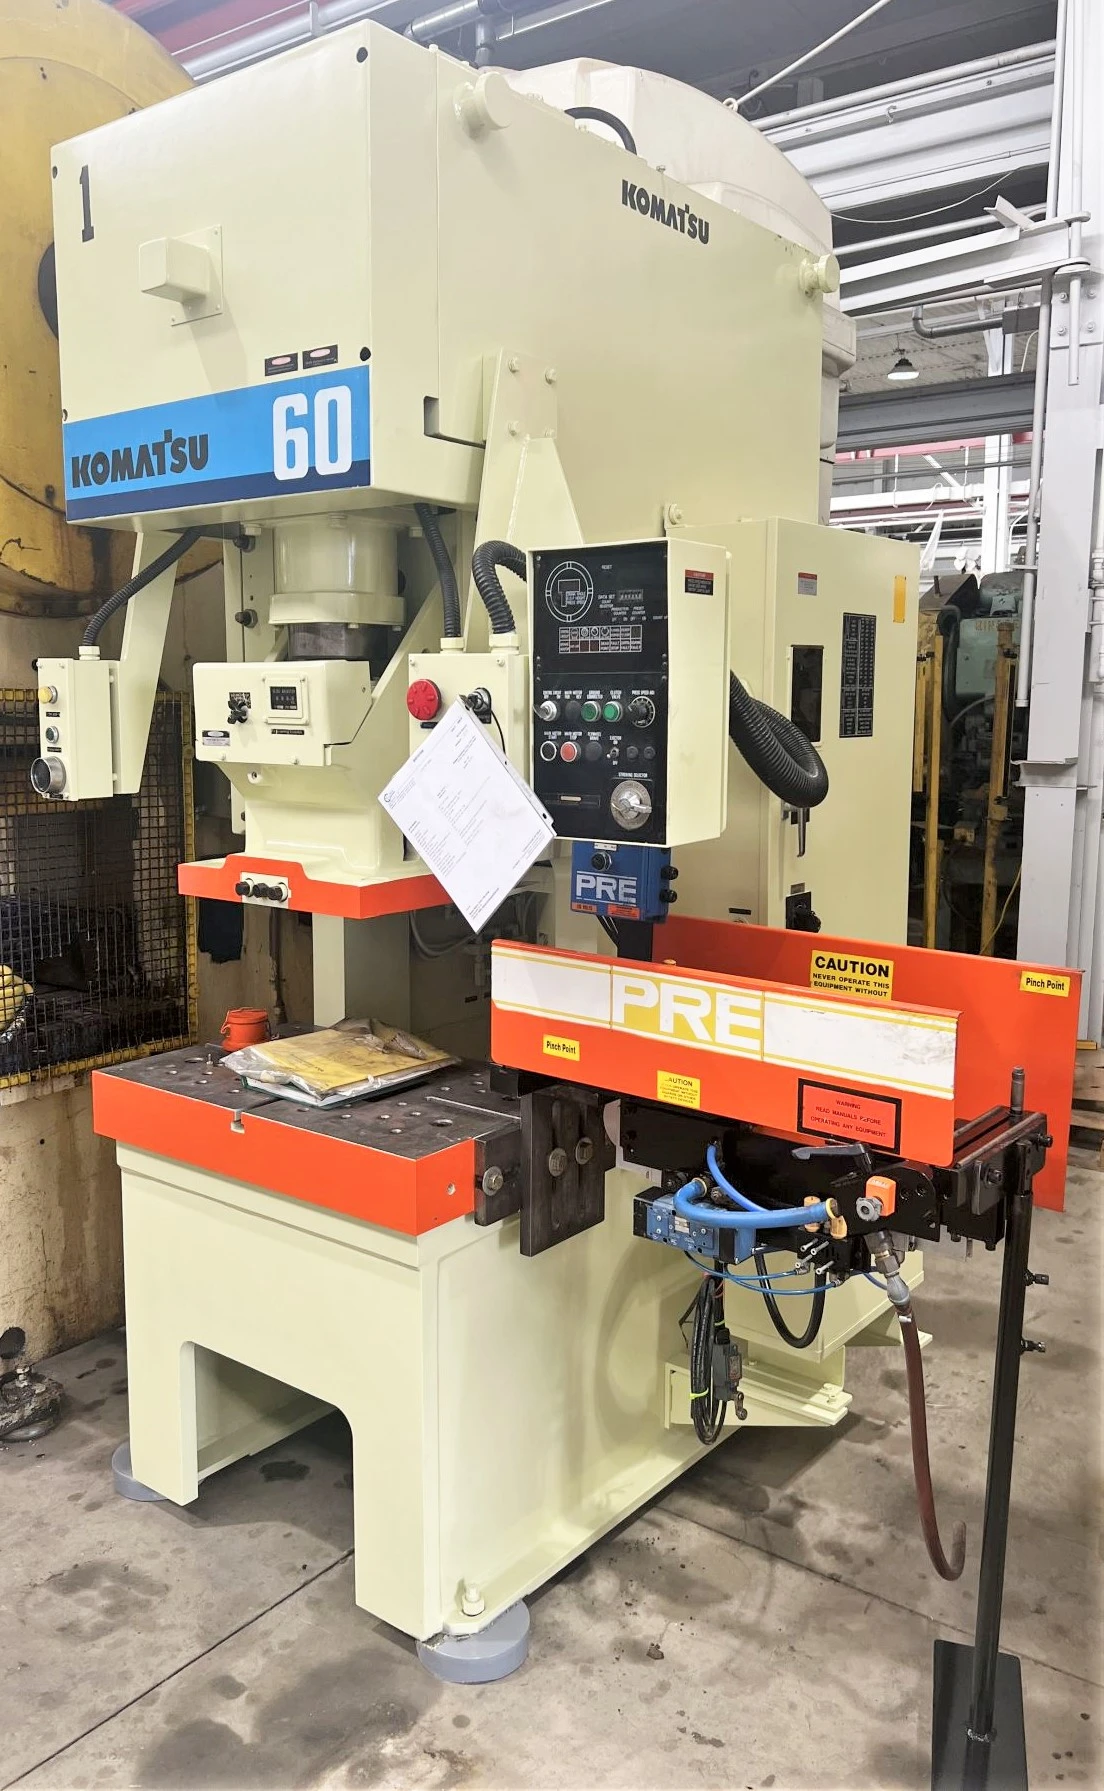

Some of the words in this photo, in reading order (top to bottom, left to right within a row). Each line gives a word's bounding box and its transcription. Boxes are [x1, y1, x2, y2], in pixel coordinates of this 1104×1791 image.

[621, 178, 710, 245] KOMATSU
[272, 385, 352, 481] 60
[71, 429, 209, 488] KOMATSU
[576, 874, 637, 904] PRE
[814, 956, 890, 978] CAUTION
[812, 972, 836, 981] NEVER
[838, 976, 870, 987] OPERATE
[873, 981, 890, 989] THIS
[813, 981, 852, 992] EQUIPMENT
[855, 987, 888, 997] WITHOUT
[1026, 977, 1045, 988] Pinch
[1046, 980, 1065, 990] Point
[612, 974, 761, 1051] PRE
[546, 1040, 561, 1050] Pinch
[562, 1043, 576, 1054] Point
[665, 1077, 693, 1087] AUTION
[815, 1106, 830, 1114] READ
[832, 1109, 857, 1120] MANUALS
[836, 1099, 861, 1109] WARNING
[810, 1116, 840, 1127] OPERATING
[855, 1127, 886, 1137] EQUIPMENT
